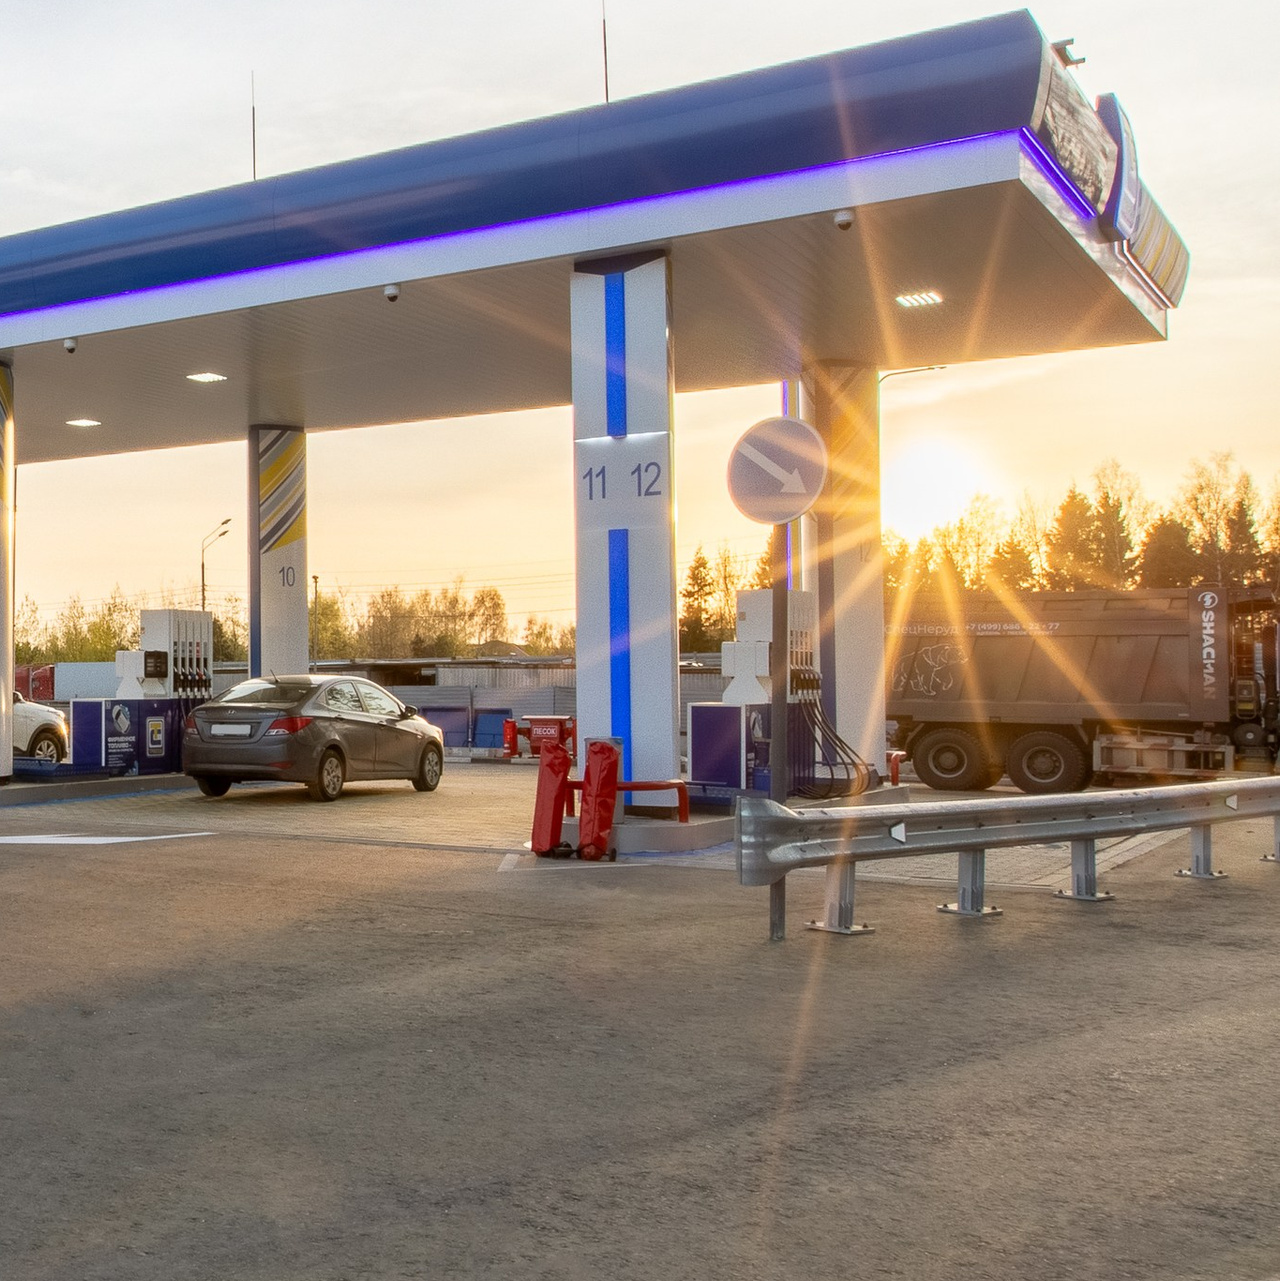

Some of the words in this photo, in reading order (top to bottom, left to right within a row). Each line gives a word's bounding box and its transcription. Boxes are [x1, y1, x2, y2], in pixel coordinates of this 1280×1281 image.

[582, 465, 606, 500] 11
[631, 461, 662, 497] 12
[278, 566, 296, 587] 10
[1201, 610, 1216, 700] SHACMAN
[533, 727, 557, 735] ПЕСОК
